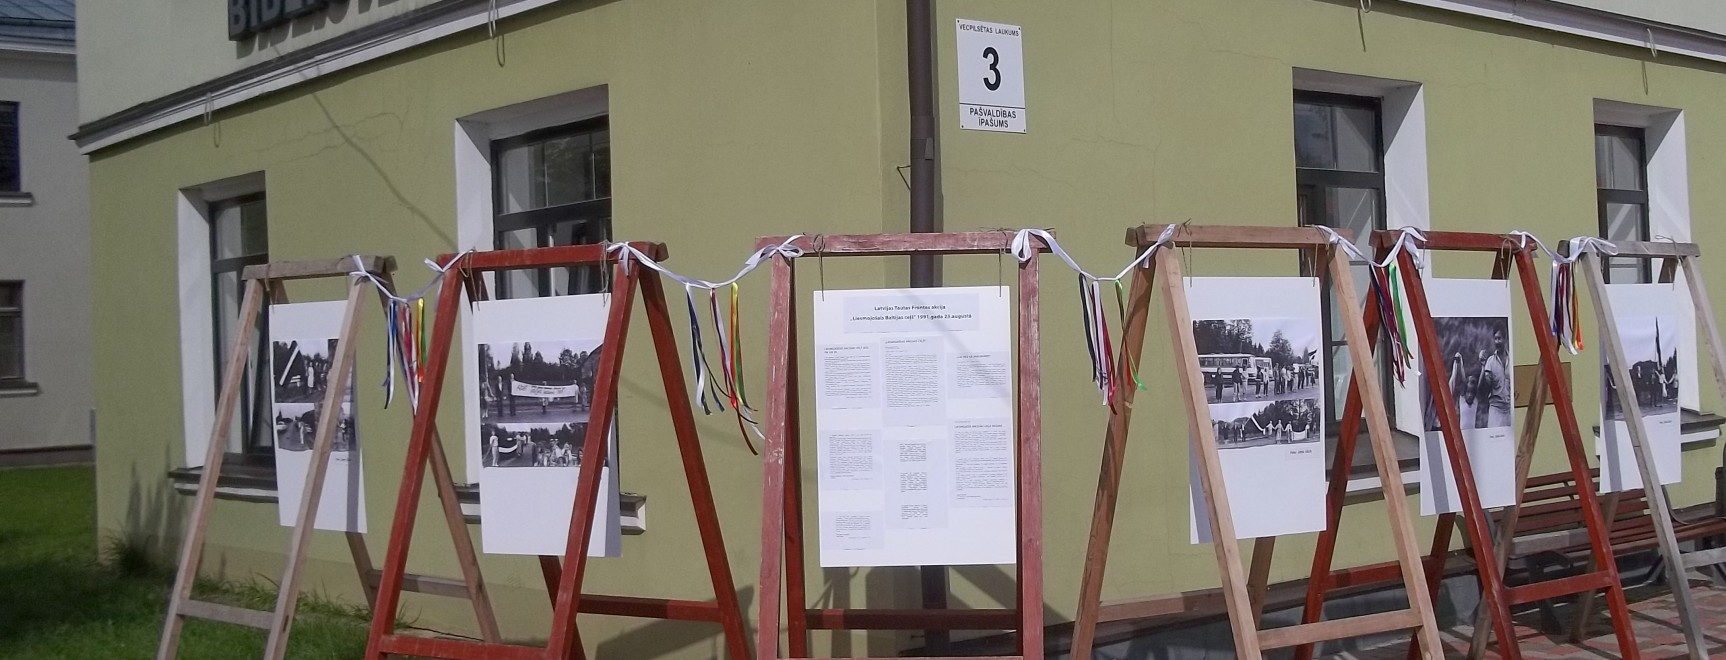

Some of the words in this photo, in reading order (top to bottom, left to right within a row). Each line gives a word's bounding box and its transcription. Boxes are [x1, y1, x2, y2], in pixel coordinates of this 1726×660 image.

[959, 24, 993, 34] VECPILSĒTAS
[995, 28, 1019, 37] LAUKUMS
[982, 46, 1001, 91] 3
[969, 107, 1016, 119] PAŠVALDĪBAS
[978, 117, 1009, 128] ĪPAŠUMS
